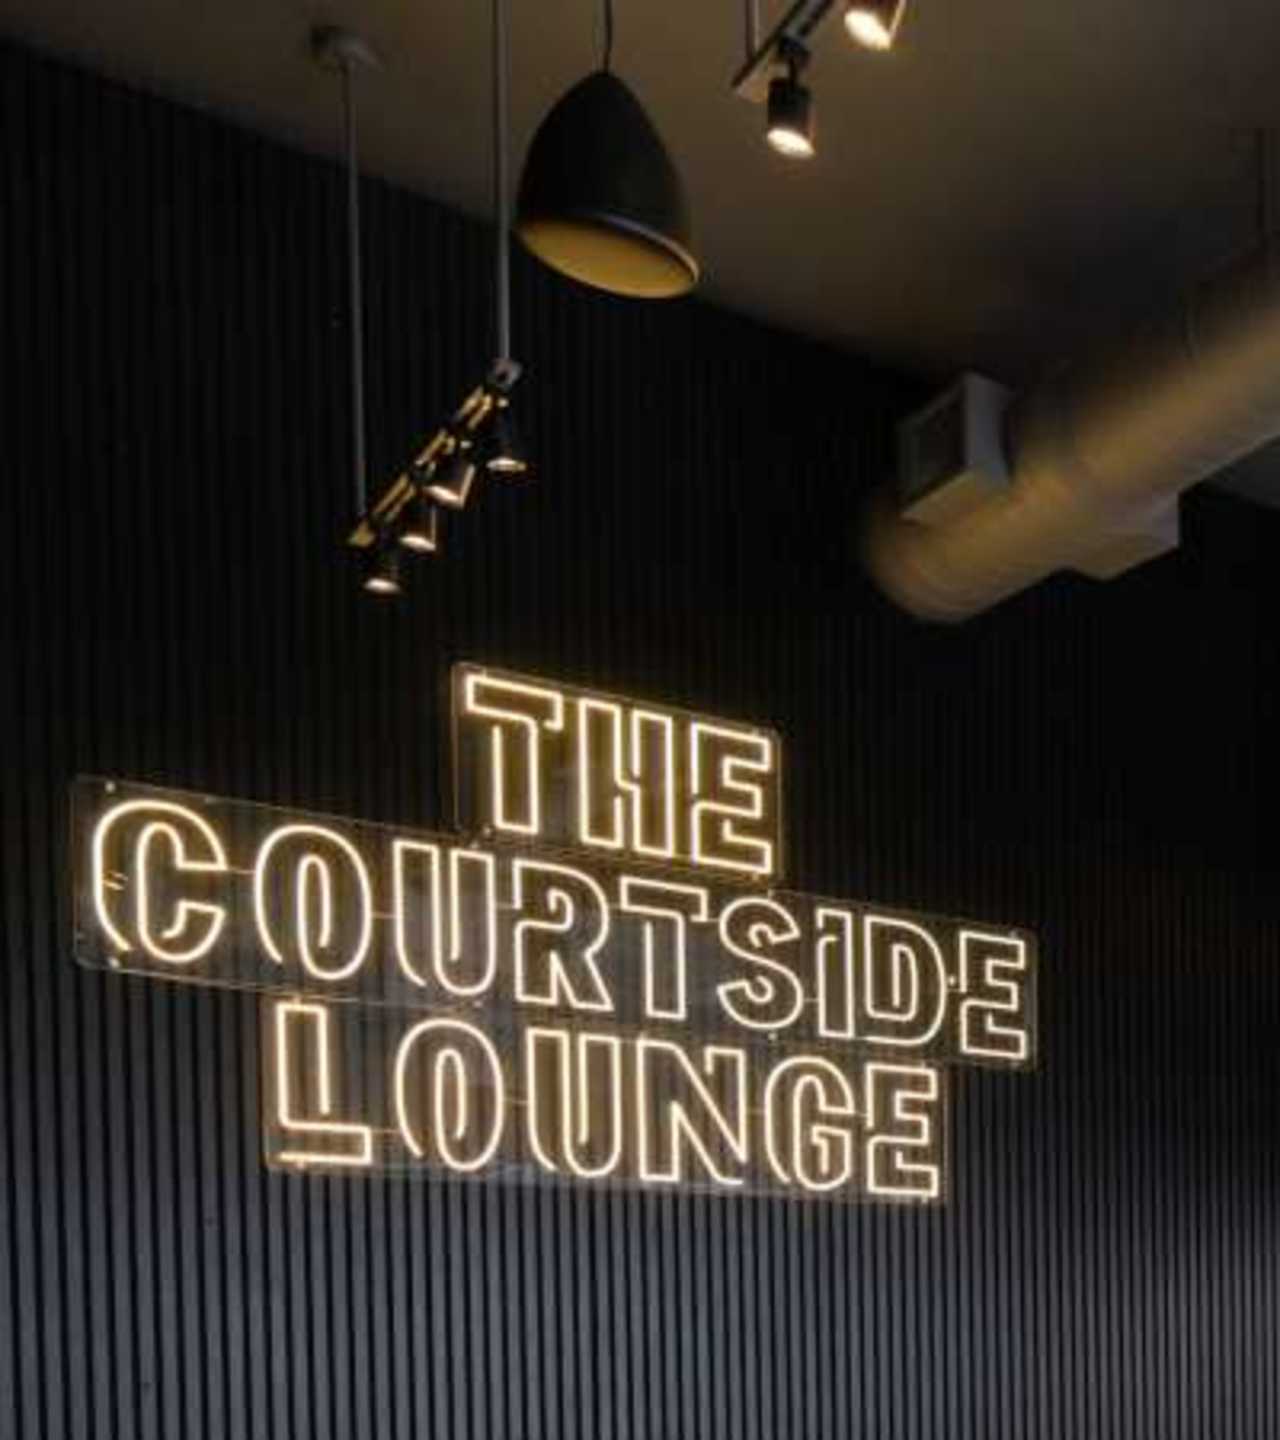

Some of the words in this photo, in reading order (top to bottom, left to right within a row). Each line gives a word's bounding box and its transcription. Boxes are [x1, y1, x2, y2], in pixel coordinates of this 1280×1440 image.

[464, 673, 772, 875] THE
[92, 799, 1026, 1060] COURTSIDE
[275, 999, 940, 1199] LOUNGE
